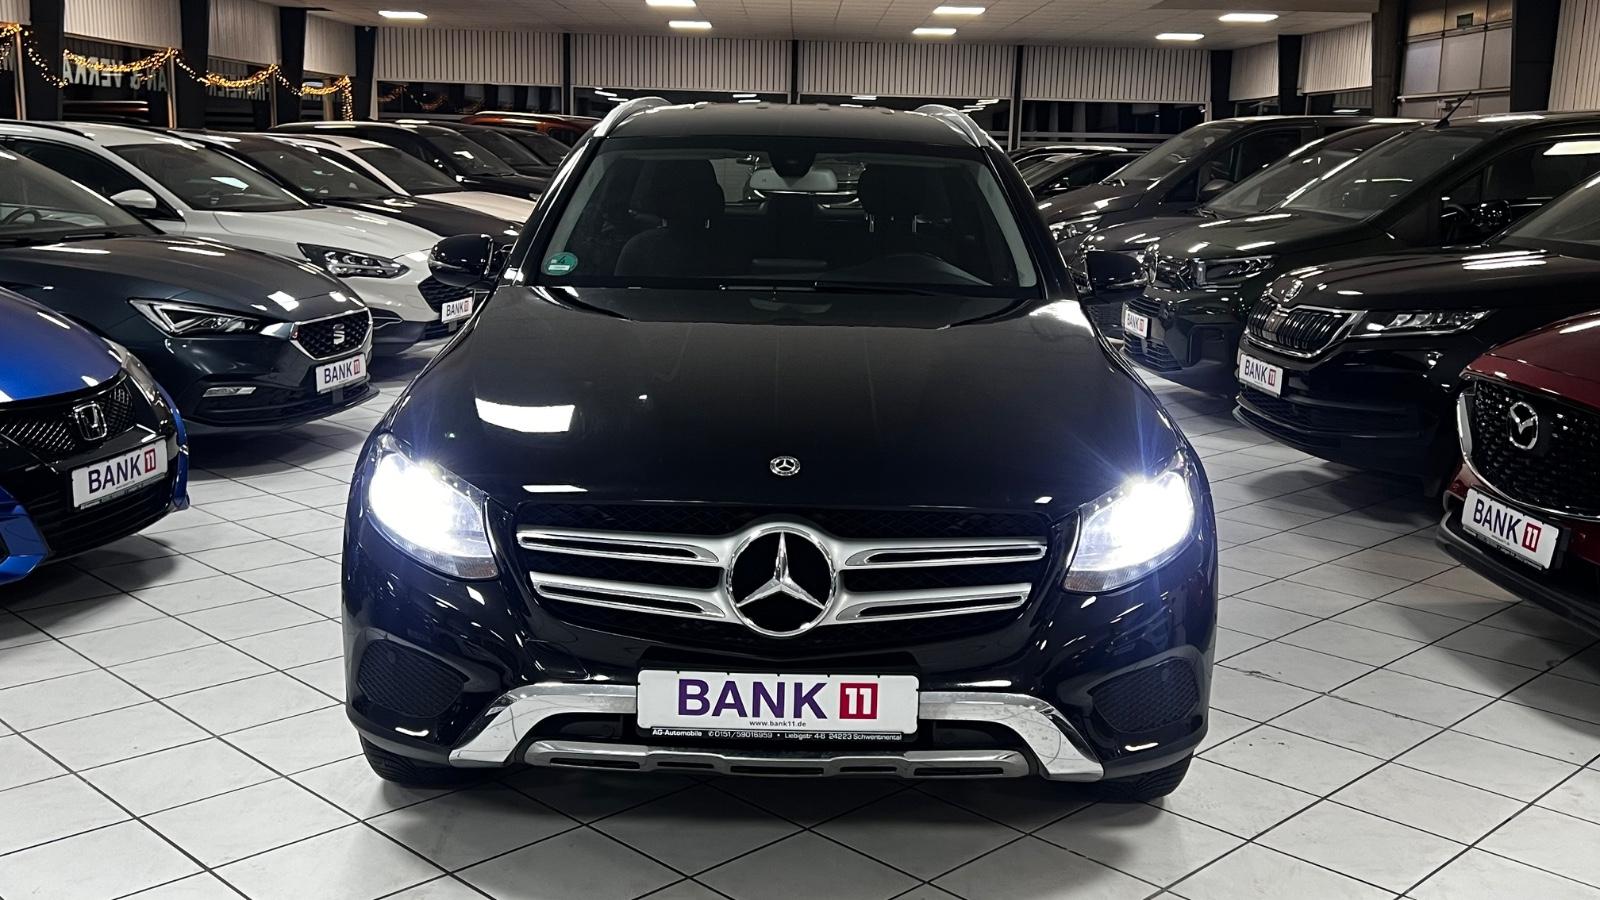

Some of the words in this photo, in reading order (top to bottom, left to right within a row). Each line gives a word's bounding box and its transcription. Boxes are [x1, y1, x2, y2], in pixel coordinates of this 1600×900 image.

[446, 301, 464, 317] BANK
[1127, 312, 1139, 331] BANK
[324, 361, 353, 384] BANK
[1245, 359, 1268, 384] BANK
[88, 454, 142, 494] BANK
[145, 451, 156, 472] 11
[1473, 498, 1522, 545] BANK
[1525, 525, 1539, 550] 11
[677, 678, 828, 719] BANK
[844, 686, 873, 716] 11
[652, 729, 703, 738] AG-Automobile
[749, 720, 807, 728] www.bank11.de
